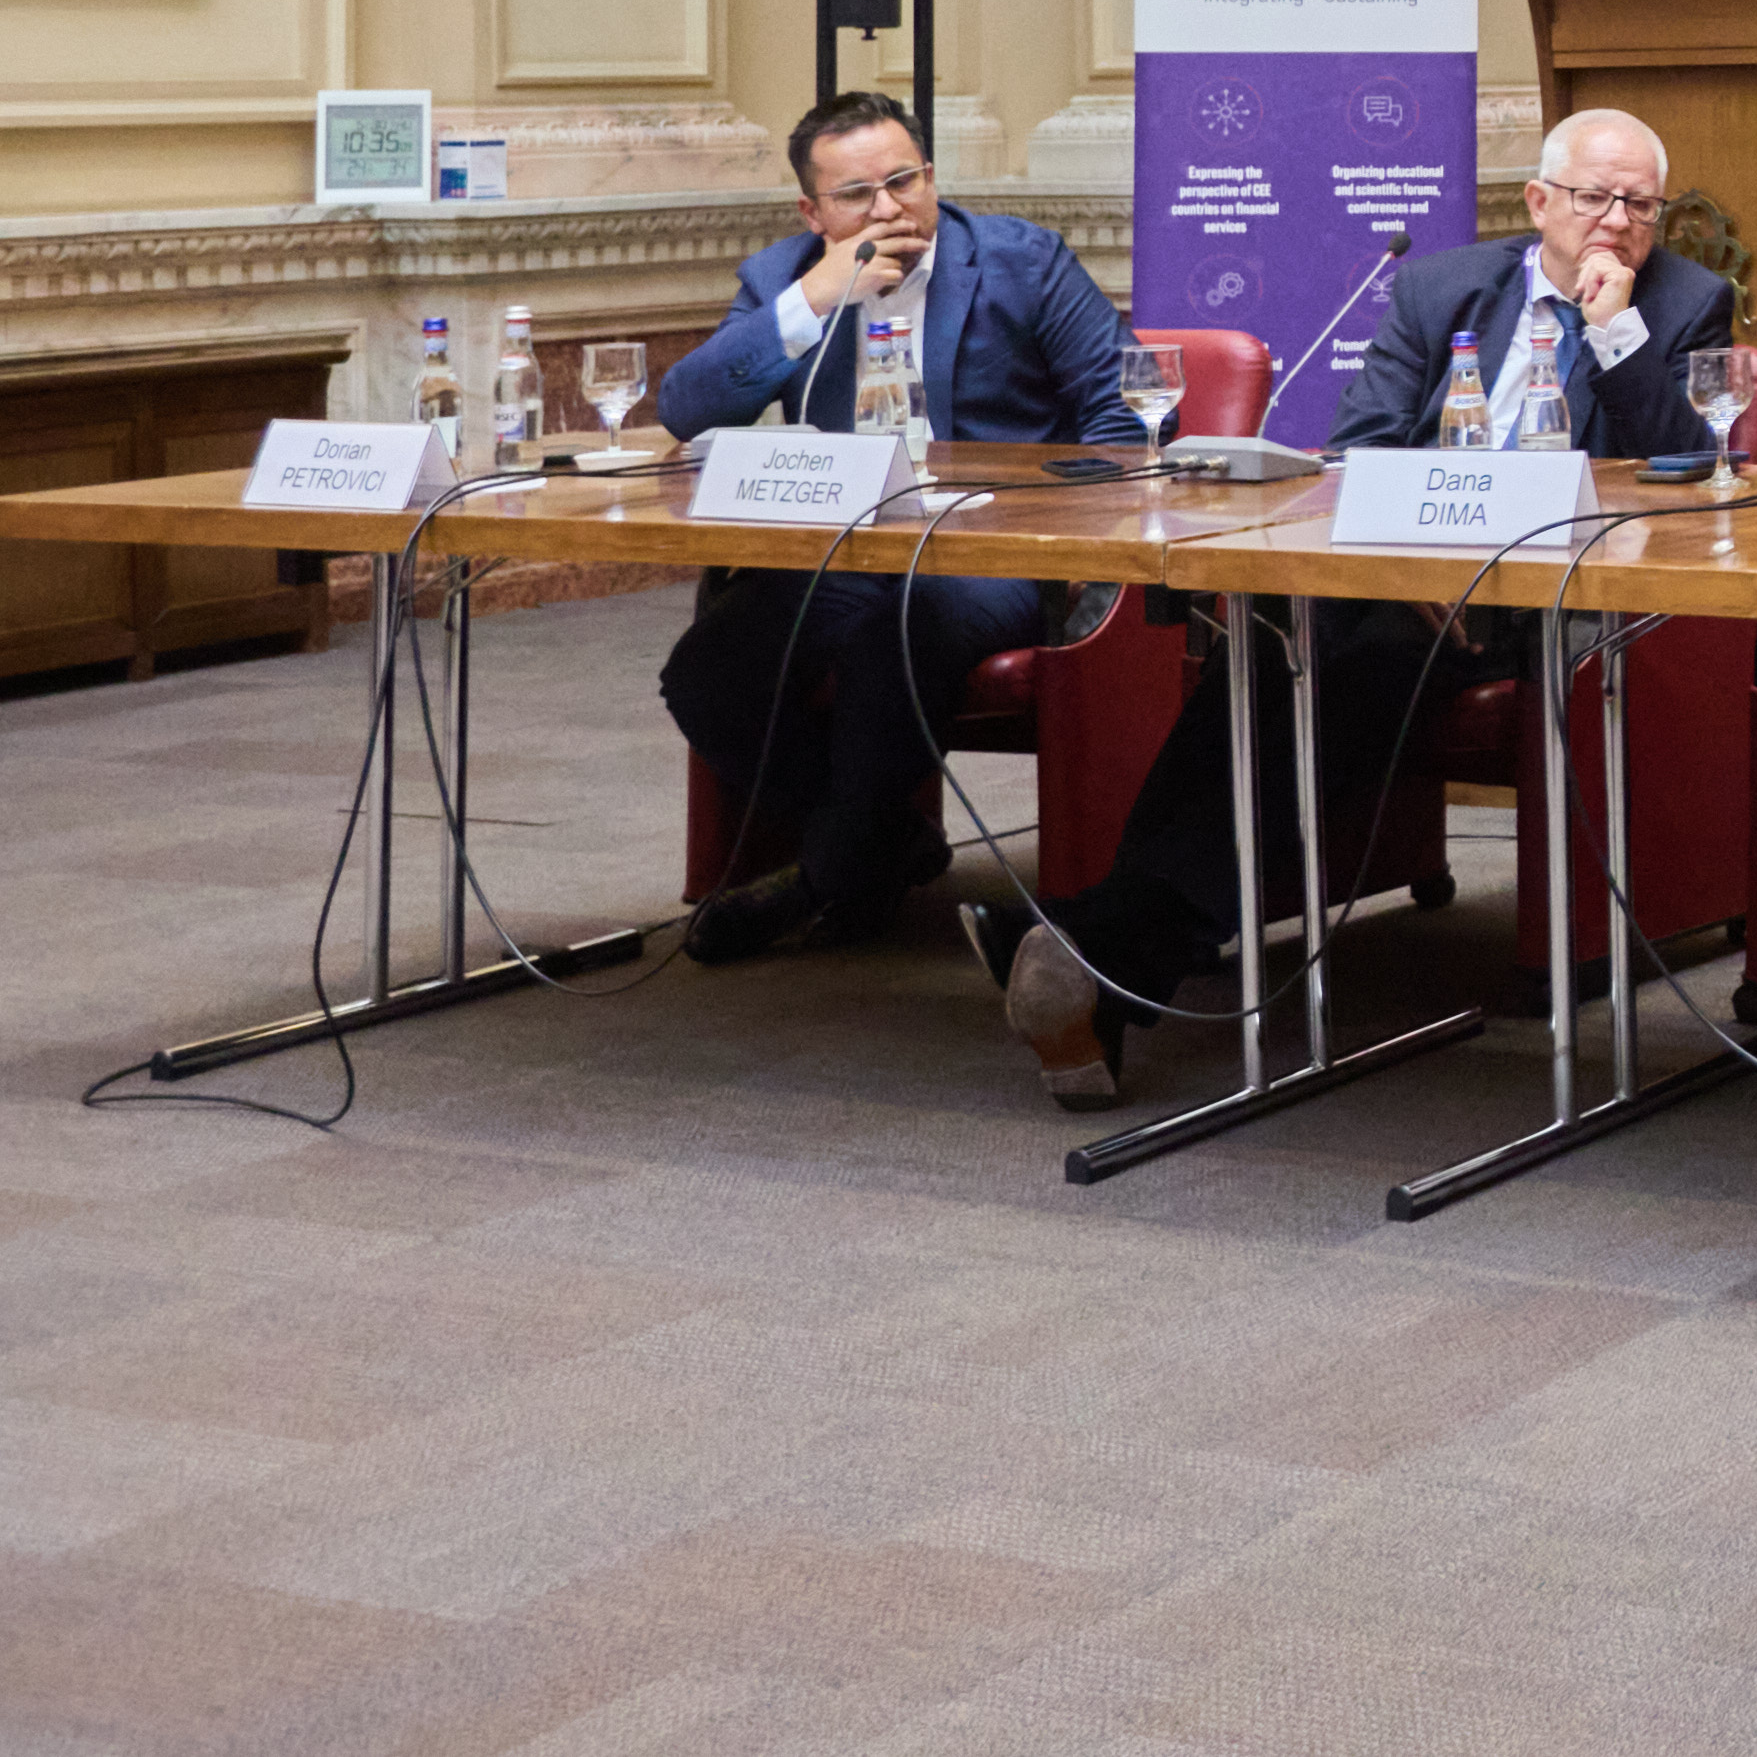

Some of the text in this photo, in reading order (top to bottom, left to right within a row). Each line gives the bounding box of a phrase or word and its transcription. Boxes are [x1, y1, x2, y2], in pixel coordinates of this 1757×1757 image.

[1188, 165, 1263, 181] Expressing the
[1332, 164, 1444, 180] Organizing educational
[1179, 183, 1271, 199] perspective of CEE
[1334, 182, 1441, 197] and scientific forums,
[1171, 201, 1279, 215] countries on financial
[1347, 200, 1429, 214] conferences and
[1203, 219, 1247, 234] services
[1371, 219, 1406, 232] events
[313, 438, 371, 459] Dorian
[762, 448, 834, 471] Jochen
[279, 466, 387, 491] PETROVICI
[1426, 468, 1493, 491] Dana
[735, 478, 843, 504] METZGER
[1418, 502, 1487, 525] DIMA
